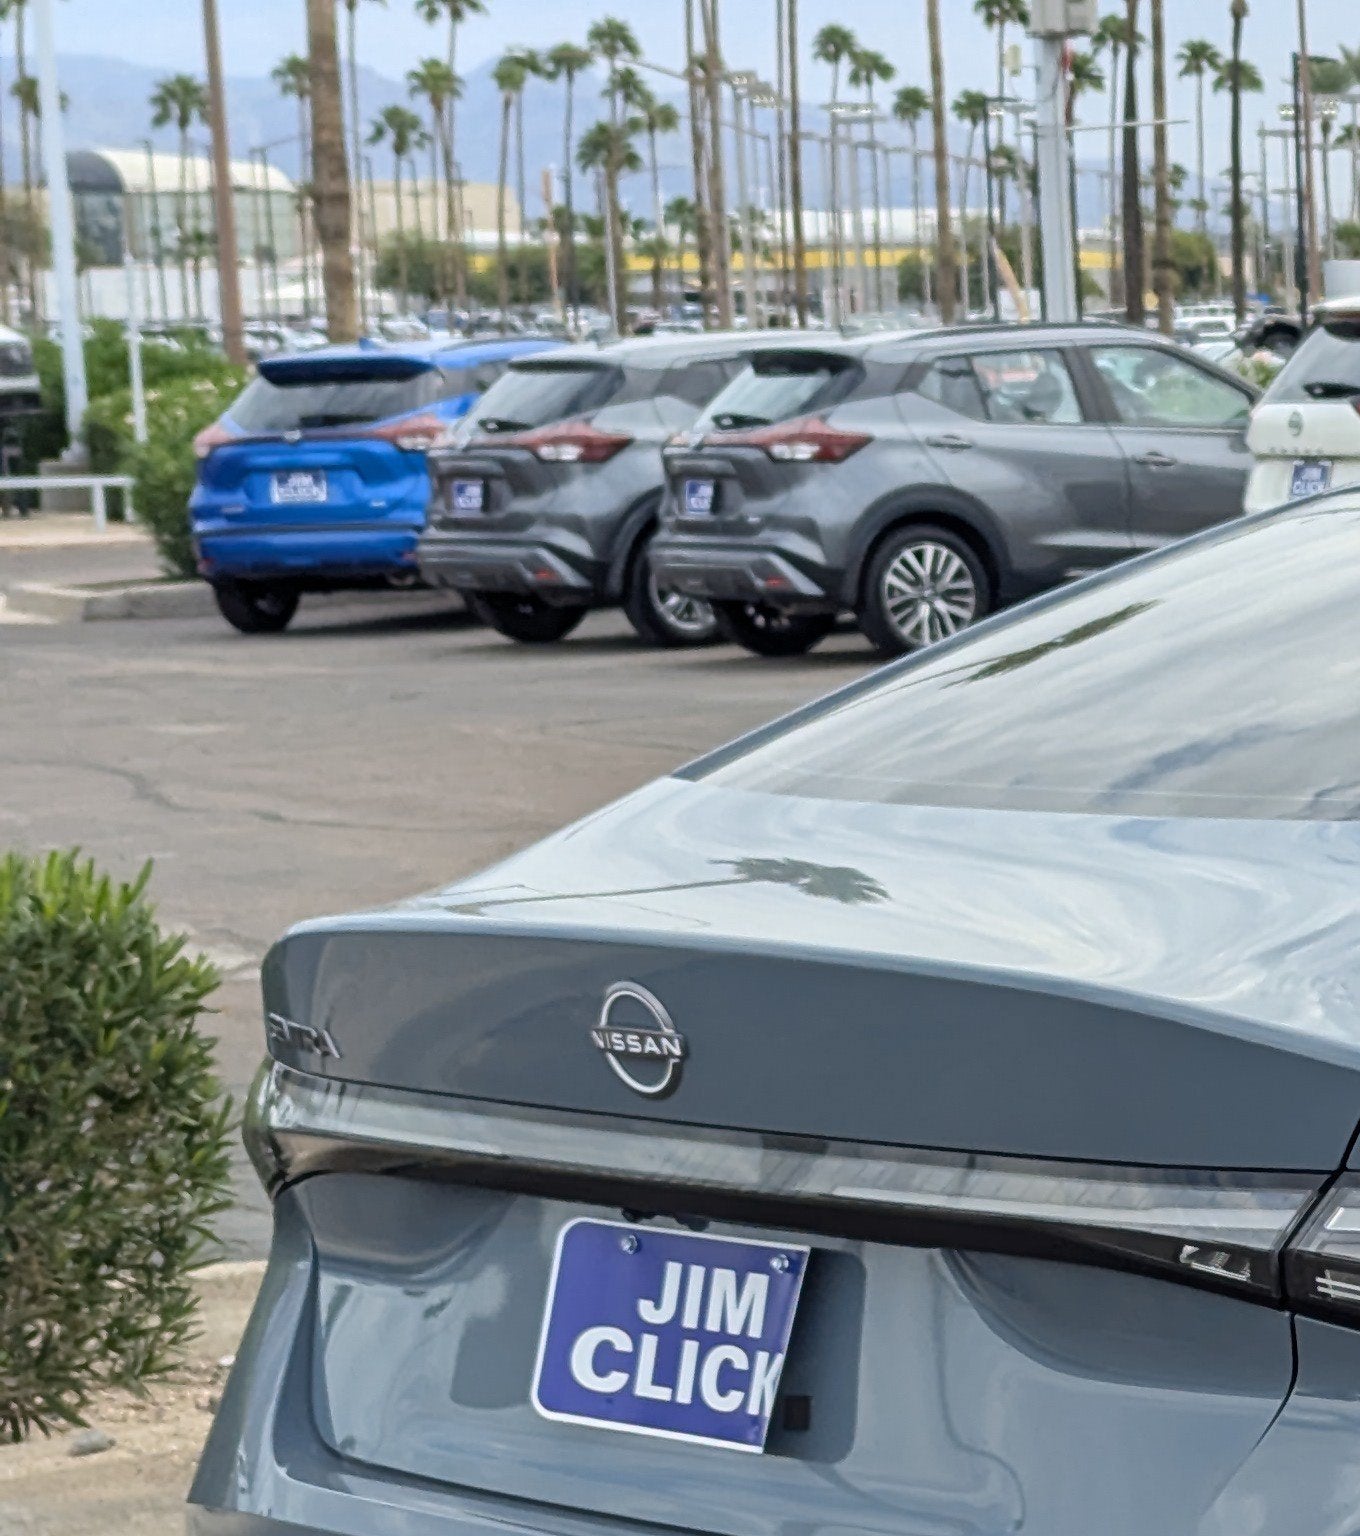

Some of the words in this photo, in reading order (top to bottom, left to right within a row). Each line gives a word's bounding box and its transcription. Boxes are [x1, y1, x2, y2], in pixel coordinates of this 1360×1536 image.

[590, 1030, 682, 1057] NISSAN
[636, 1261, 770, 1339] JIM
[569, 1325, 786, 1418] CLICK
